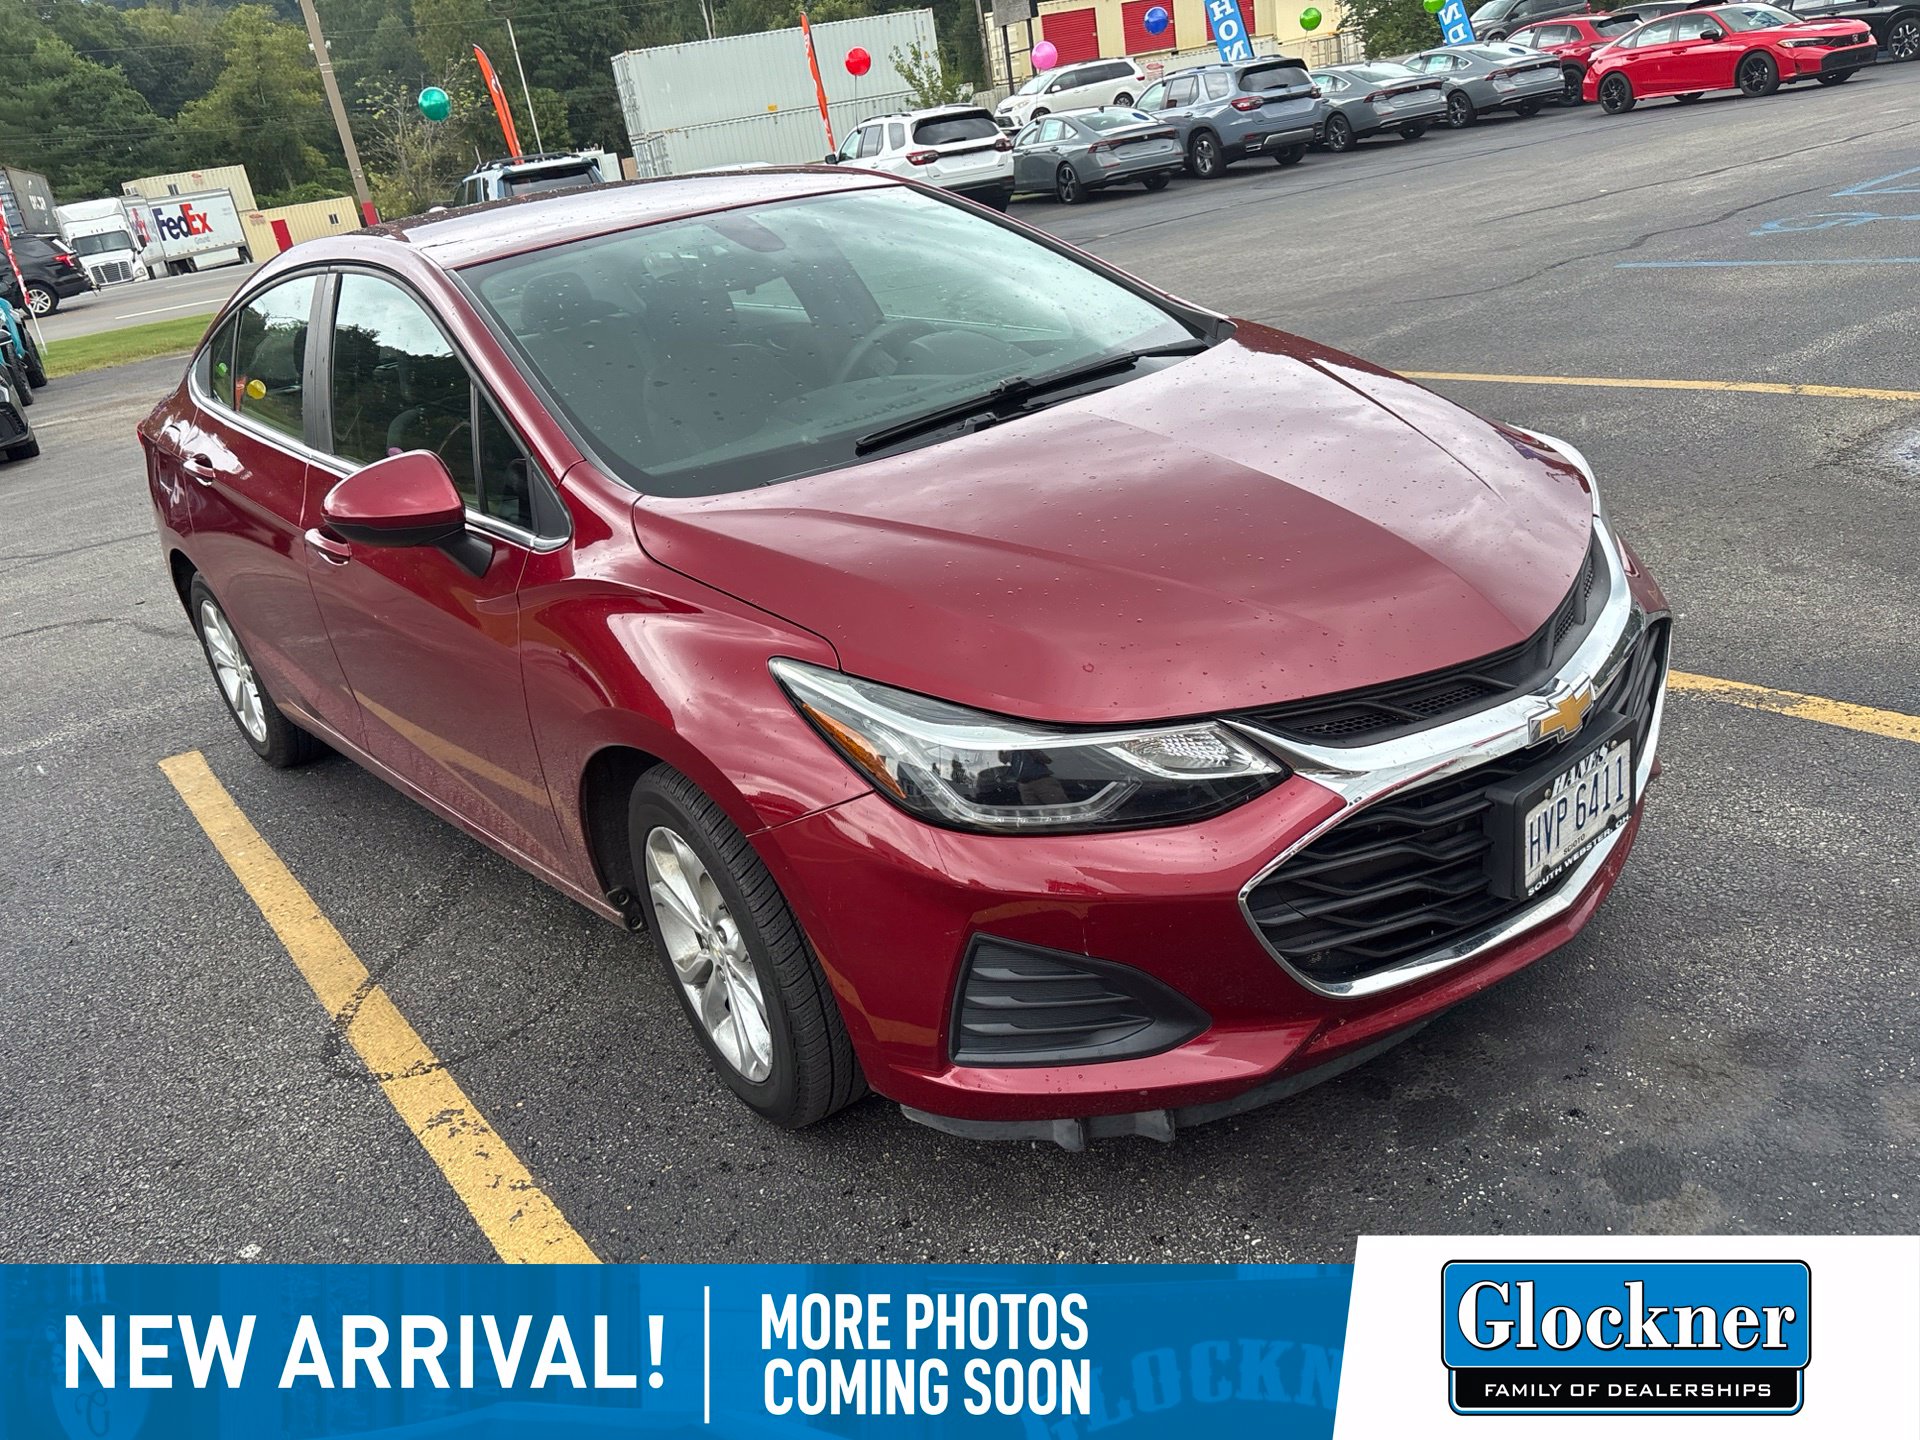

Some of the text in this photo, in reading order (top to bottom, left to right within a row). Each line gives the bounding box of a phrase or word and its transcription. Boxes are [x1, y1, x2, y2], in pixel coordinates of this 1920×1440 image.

[152, 203, 213, 241] FedEx
[1529, 754, 1624, 869] HVP 6411
[1563, 834, 1586, 855] SCIOTO
[1527, 865, 1562, 896] SOUTH
